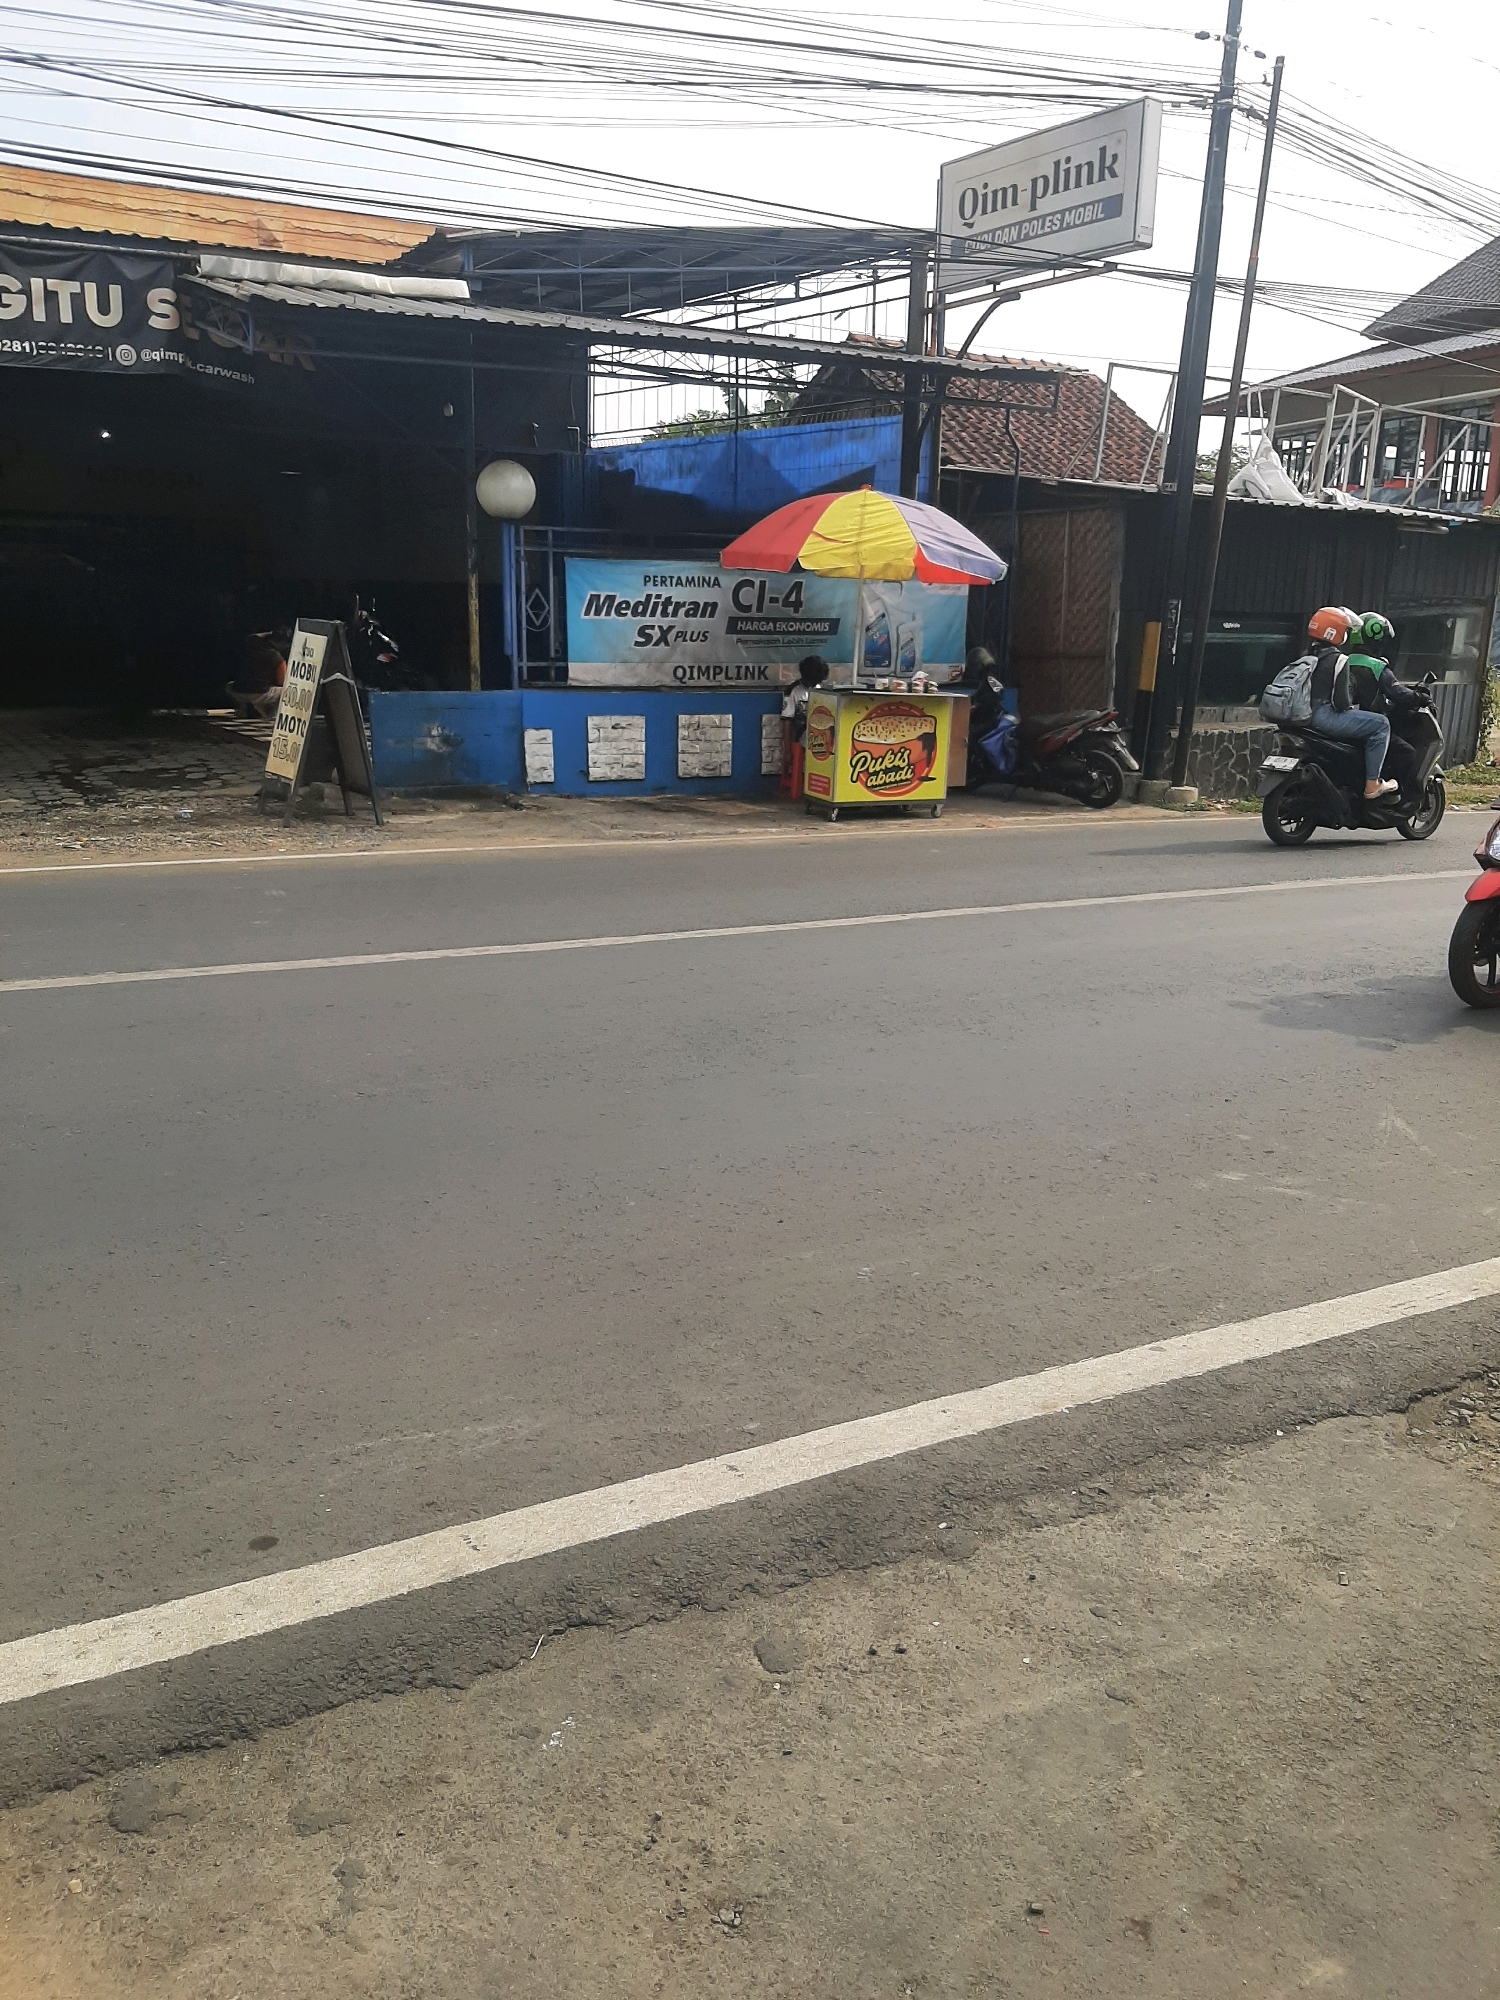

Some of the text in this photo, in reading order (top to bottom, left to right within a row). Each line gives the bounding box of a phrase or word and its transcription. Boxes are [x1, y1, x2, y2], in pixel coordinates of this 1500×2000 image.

[958, 145, 1119, 230] Qim-plink
[994, 226, 1019, 244] DAN
[1021, 214, 1061, 239] POLES
[1063, 203, 1105, 228] MOBIL
[643, 575, 722, 588] PERTAMINA
[583, 592, 719, 619] Meditran
[732, 578, 805, 614] CI-4
[633, 624, 710, 648] SX PLUS
[737, 621, 830, 632] HARGA EKONOMIS
[672, 665, 769, 682] QIMPLINK
[851, 748, 911, 782] Pukis
[867, 765, 915, 787] abadi
